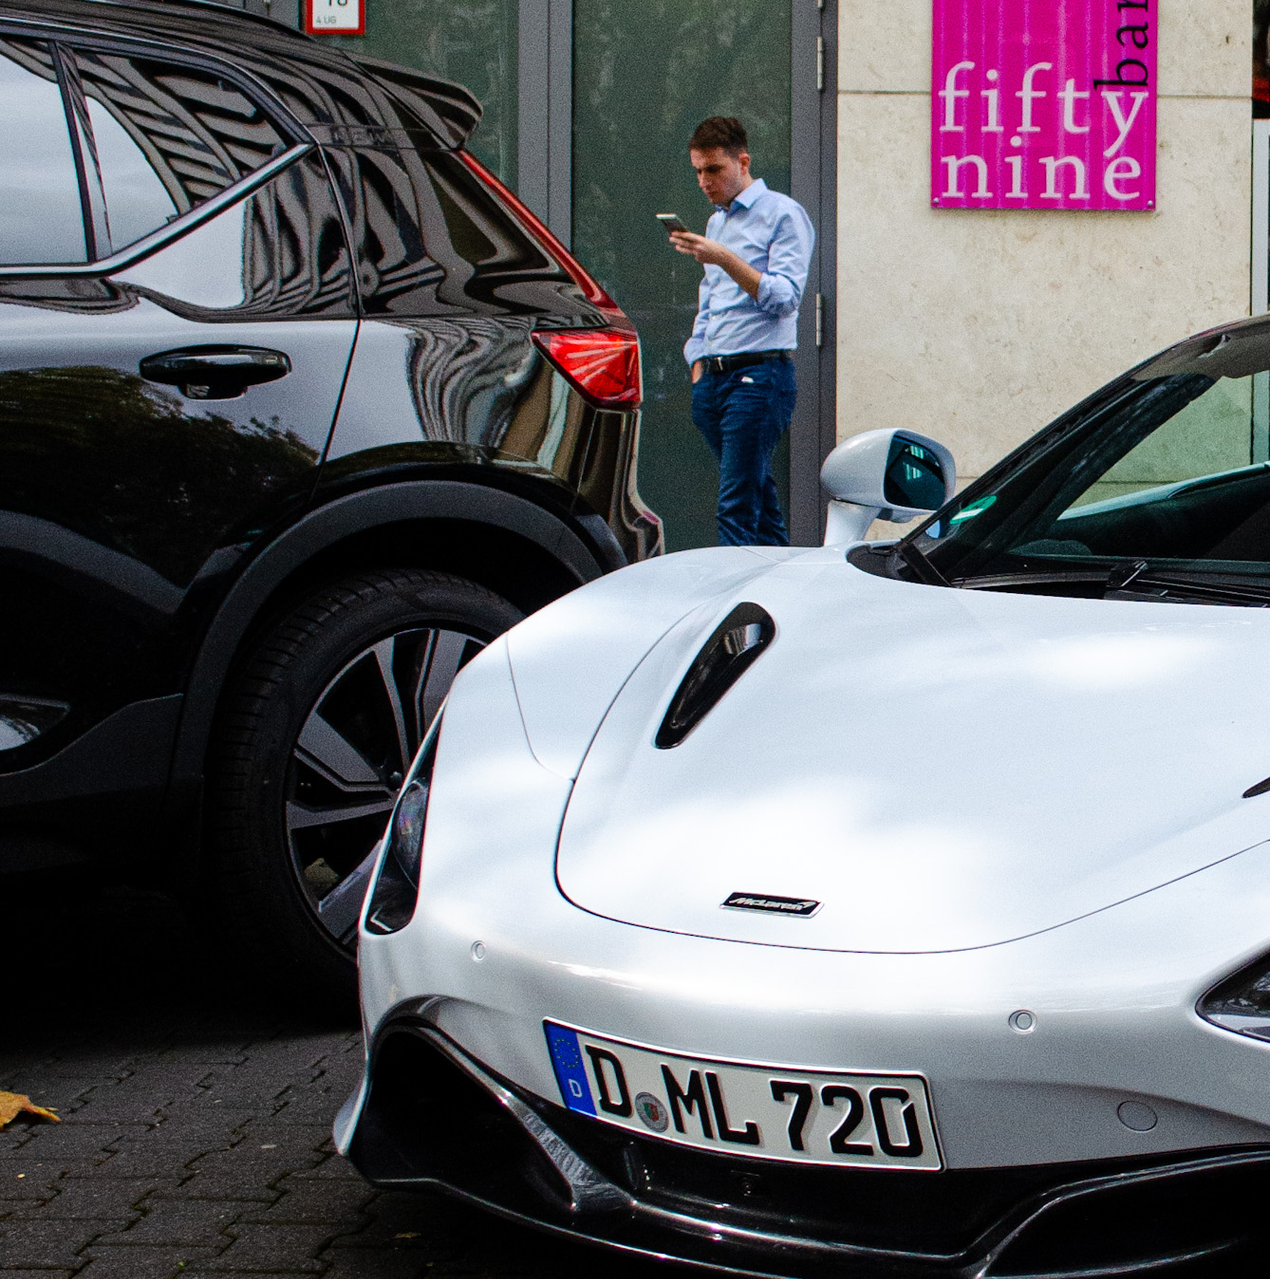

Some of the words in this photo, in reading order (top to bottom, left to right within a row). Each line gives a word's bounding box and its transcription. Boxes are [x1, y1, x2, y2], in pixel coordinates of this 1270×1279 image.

[938, 61, 1149, 158] fifty
[940, 135, 1142, 200] nine
[728, 897, 804, 911] McLaren
[568, 1078, 583, 1098] D
[585, 1044, 633, 1119] D
[661, 1064, 760, 1146] ML
[769, 1077, 924, 1157] 720
